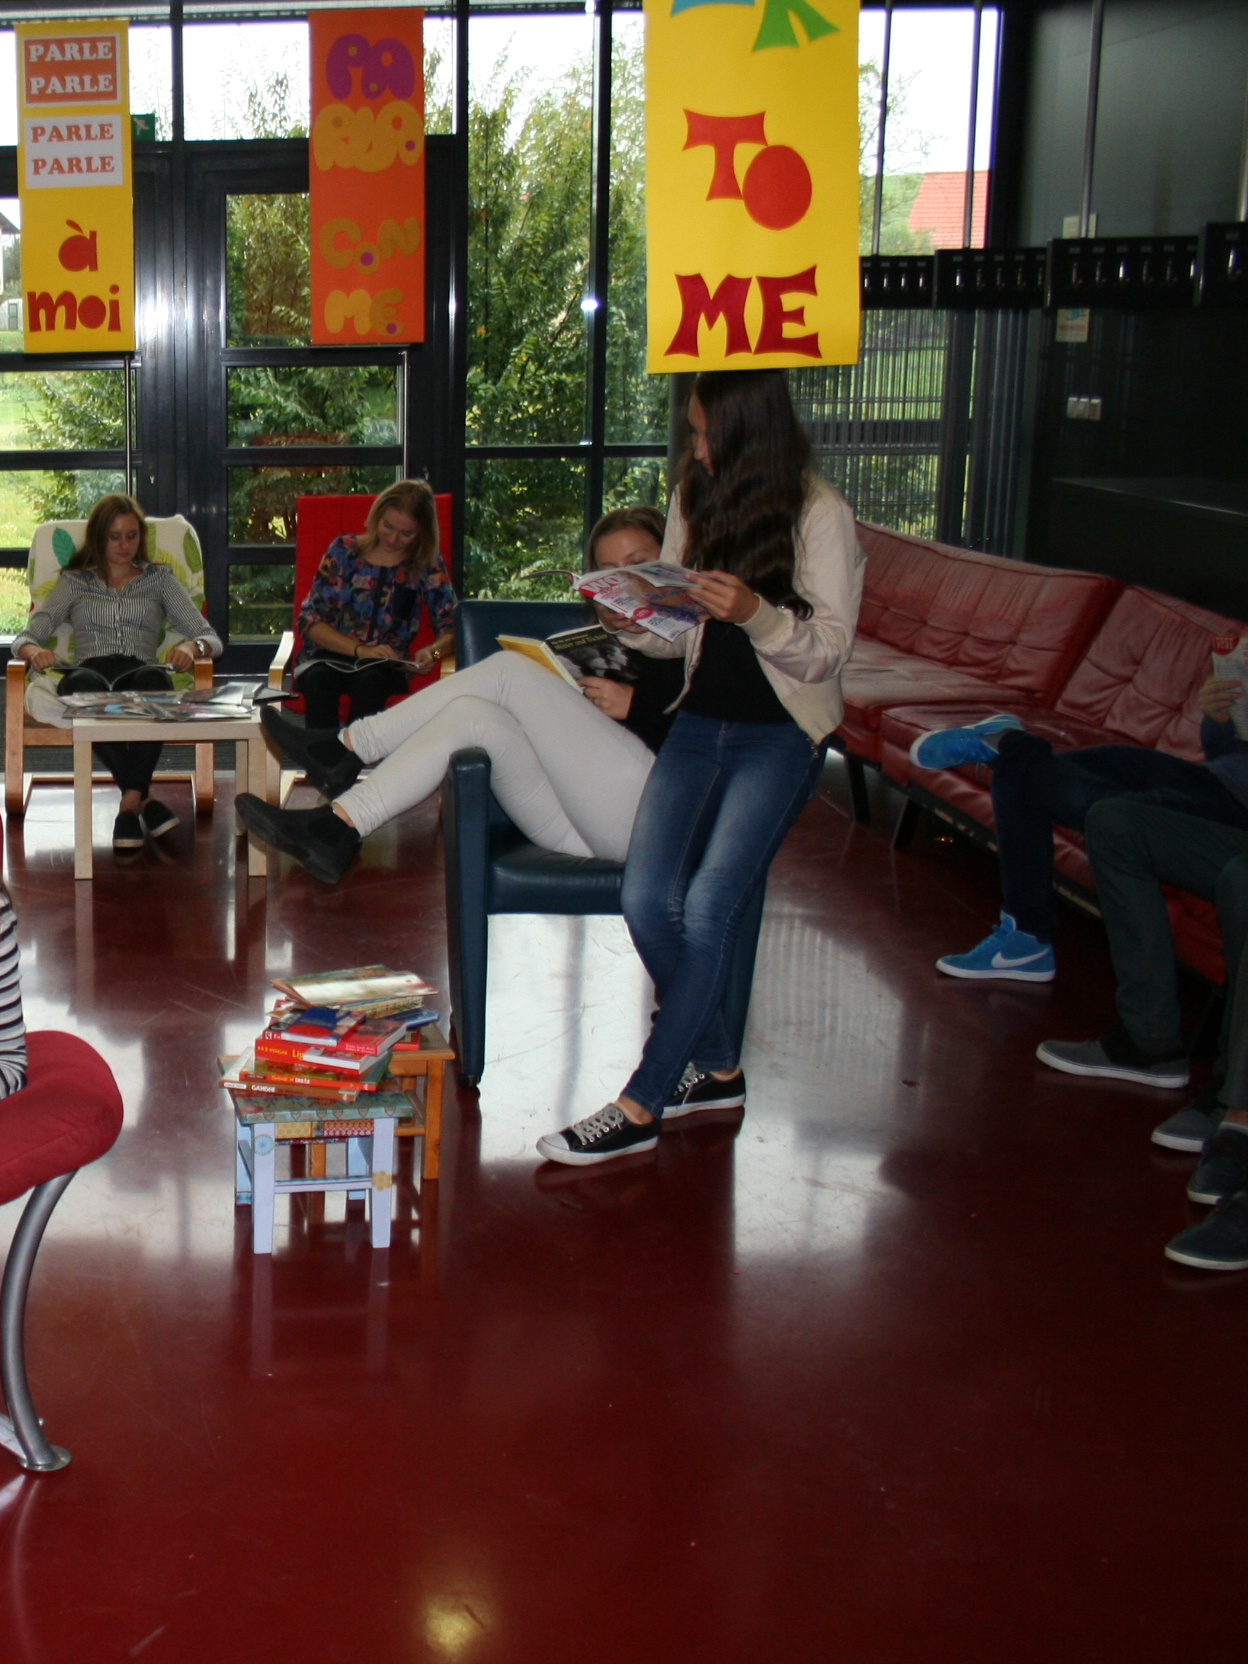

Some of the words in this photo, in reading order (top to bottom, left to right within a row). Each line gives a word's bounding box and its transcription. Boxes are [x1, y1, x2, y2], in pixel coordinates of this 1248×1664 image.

[28, 41, 113, 63] PARLE
[29, 73, 113, 96] PARLE
[30, 122, 114, 144] PARLE
[31, 154, 115, 177] PARLE
[682, 108, 813, 231] TO
[319, 216, 422, 275] CON
[26, 283, 121, 333] moi
[324, 288, 405, 337] ME
[663, 264, 824, 359] ME
